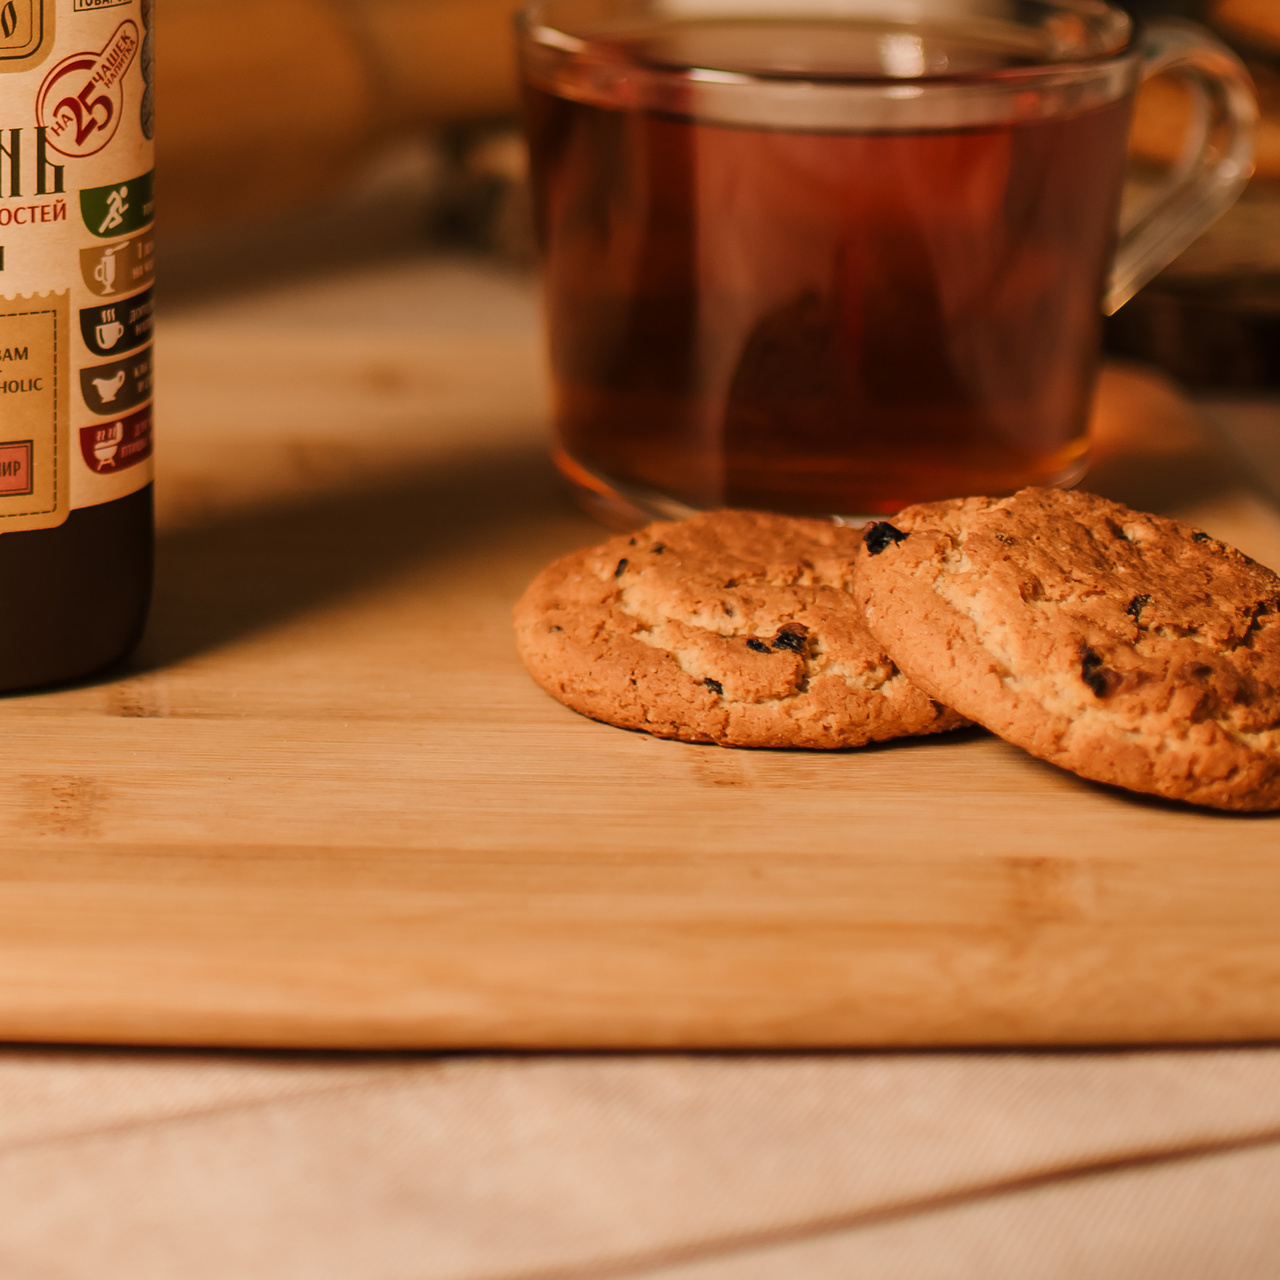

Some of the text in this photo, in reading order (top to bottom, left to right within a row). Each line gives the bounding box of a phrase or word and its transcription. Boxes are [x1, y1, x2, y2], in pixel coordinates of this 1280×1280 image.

[50, 30, 131, 147] НА 25 ЧАШЕК
[104, 39, 136, 89] НАПИТКА
